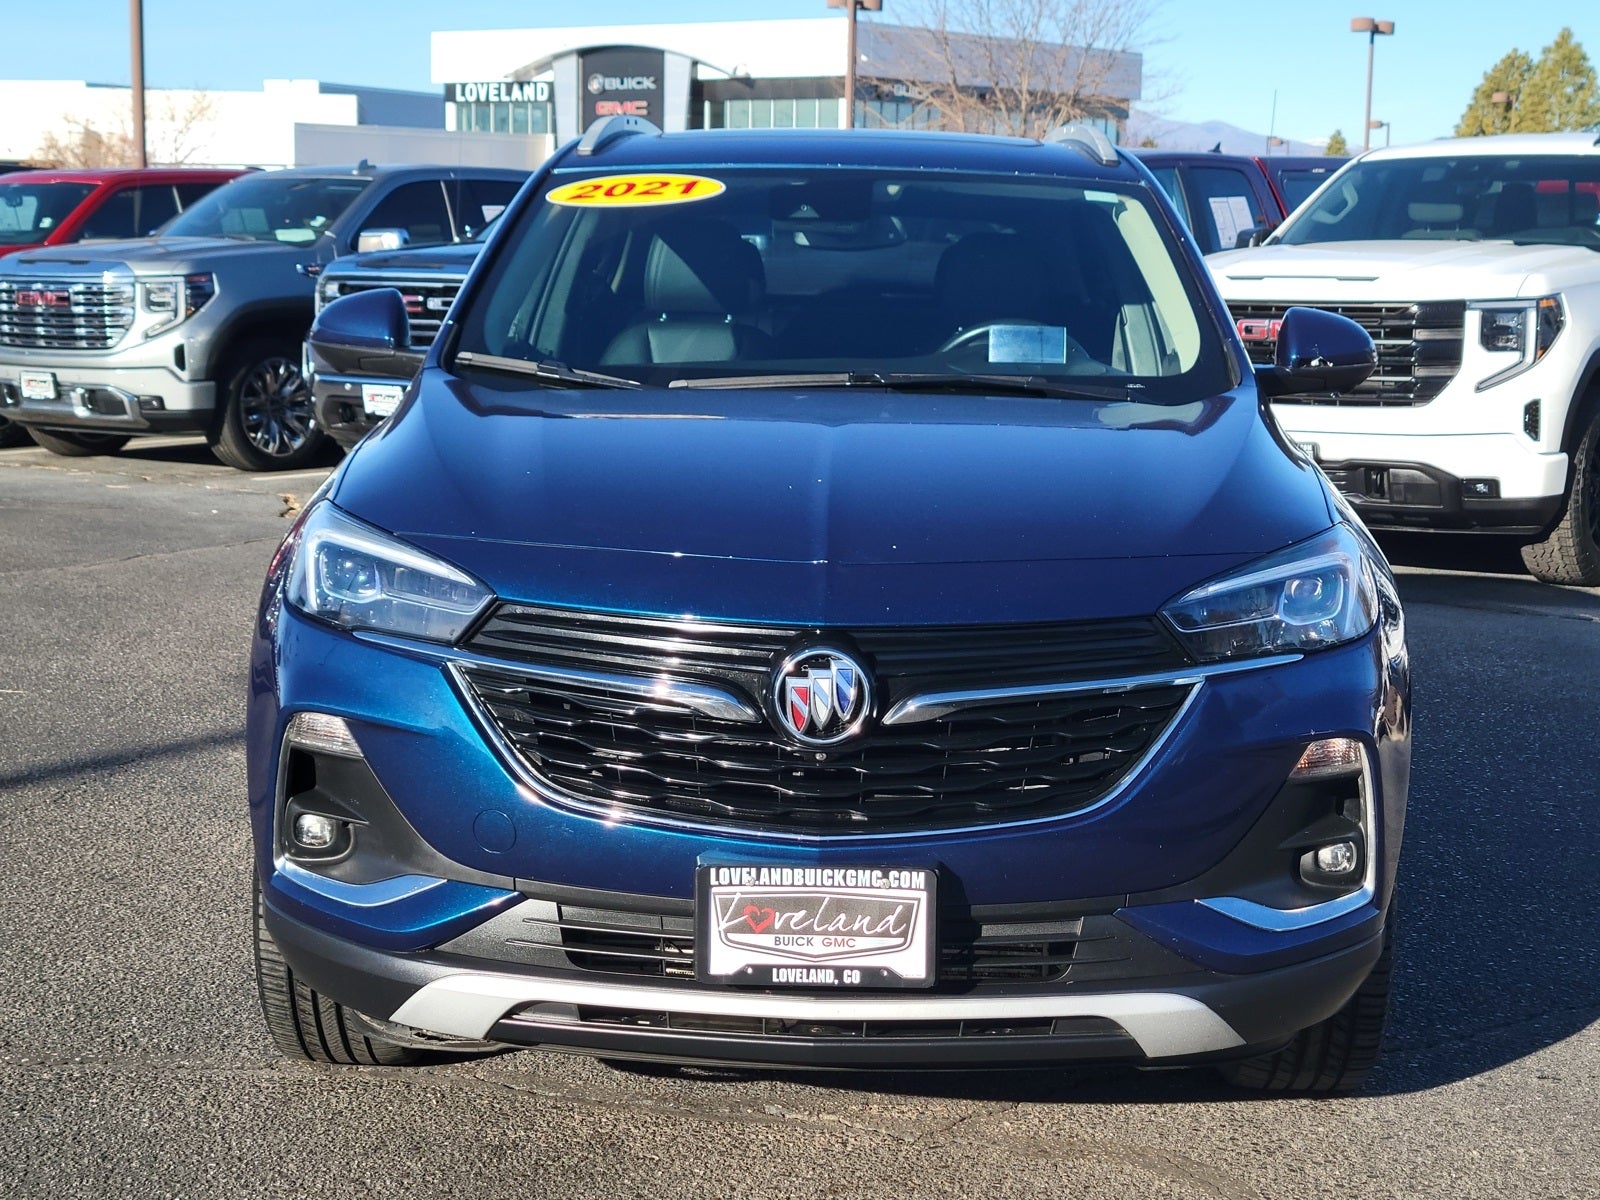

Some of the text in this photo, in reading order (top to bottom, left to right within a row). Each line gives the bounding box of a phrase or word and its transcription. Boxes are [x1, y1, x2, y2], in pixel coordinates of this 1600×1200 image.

[604, 76, 657, 90] BUICK
[455, 82, 549, 102] LOVELAND
[596, 101, 648, 115] GMC
[567, 180, 701, 200] 2021
[17, 290, 69, 306] GMC
[709, 867, 925, 889] LOVELANDBUICKGMCCOM
[774, 936, 857, 948] BUICK GMC
[772, 968, 861, 985] LOVELAND, CO
